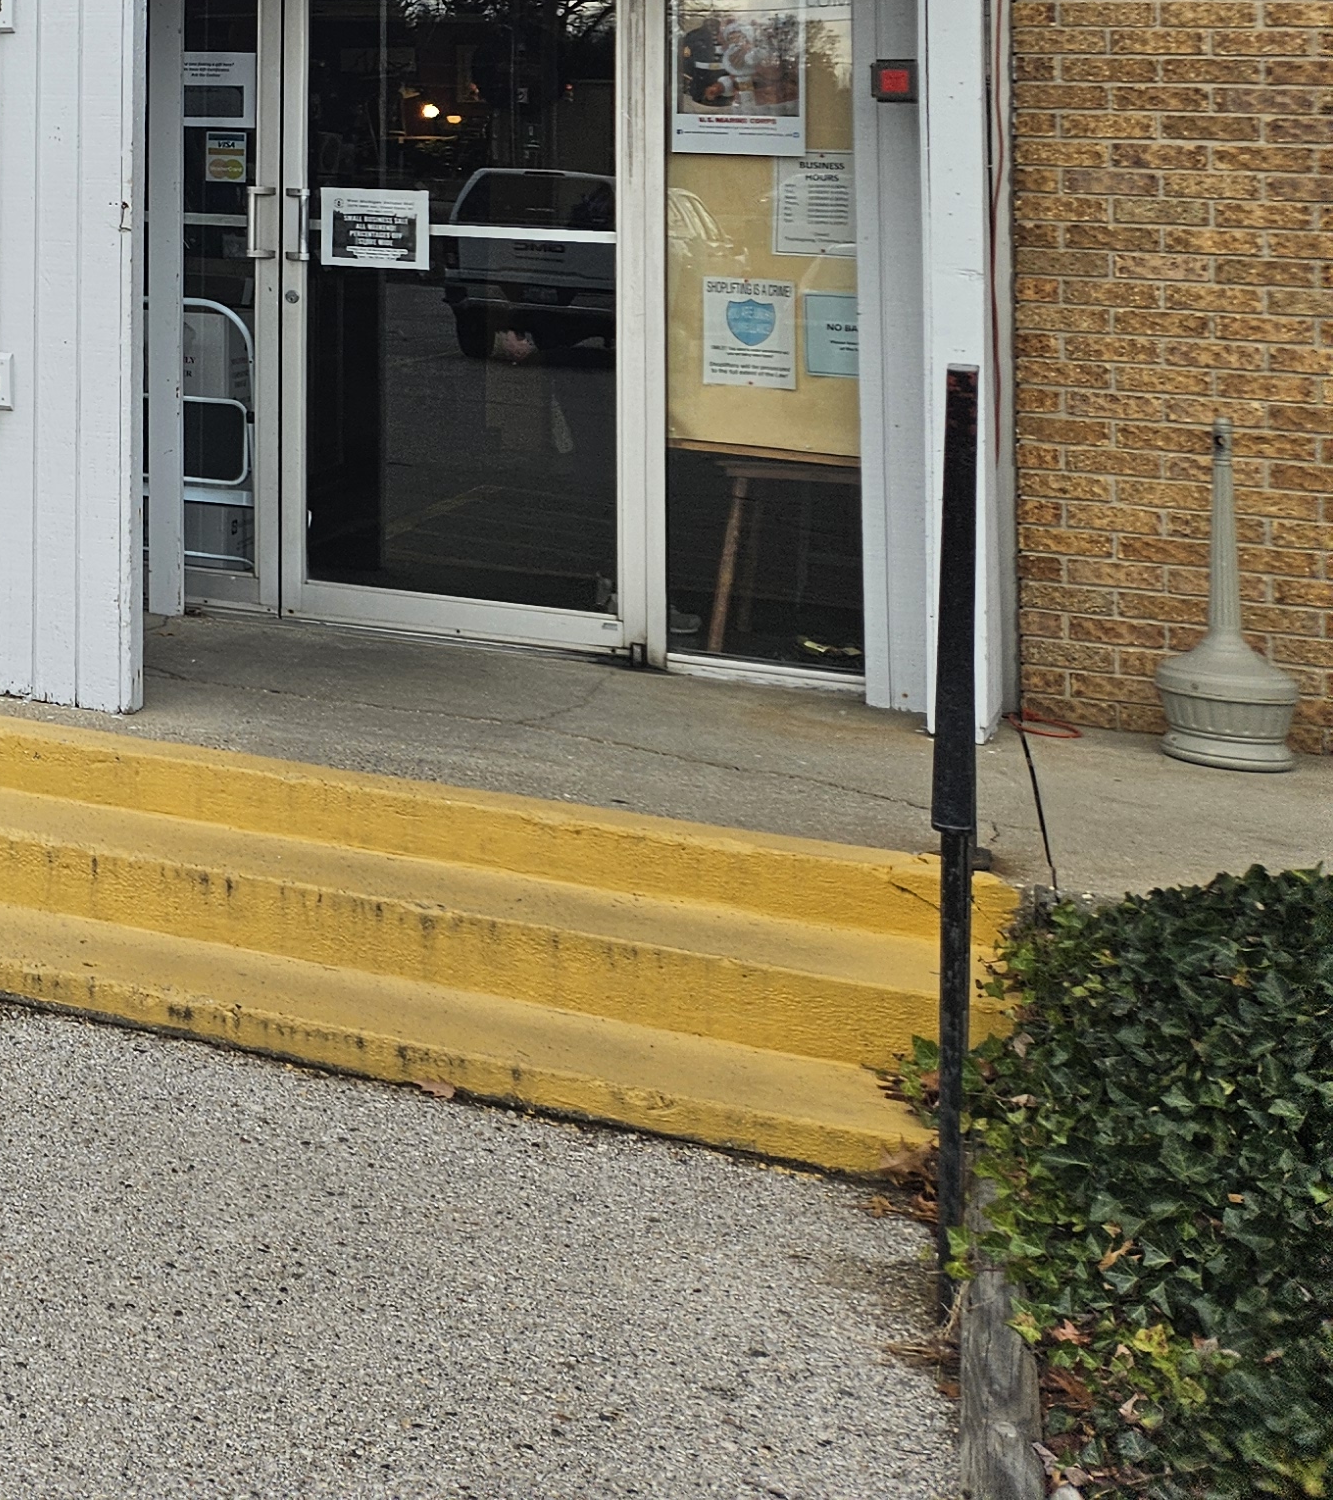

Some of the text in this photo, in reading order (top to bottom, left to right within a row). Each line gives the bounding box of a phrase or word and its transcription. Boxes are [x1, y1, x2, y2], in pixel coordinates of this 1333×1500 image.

[799, 161, 845, 170] BUSINESS
[805, 174, 839, 182] HOURS
[706, 280, 752, 295] SHOPLIFTING
[753, 283, 760, 296] IS
[761, 284, 766, 296] A
[826, 323, 842, 332] NO
